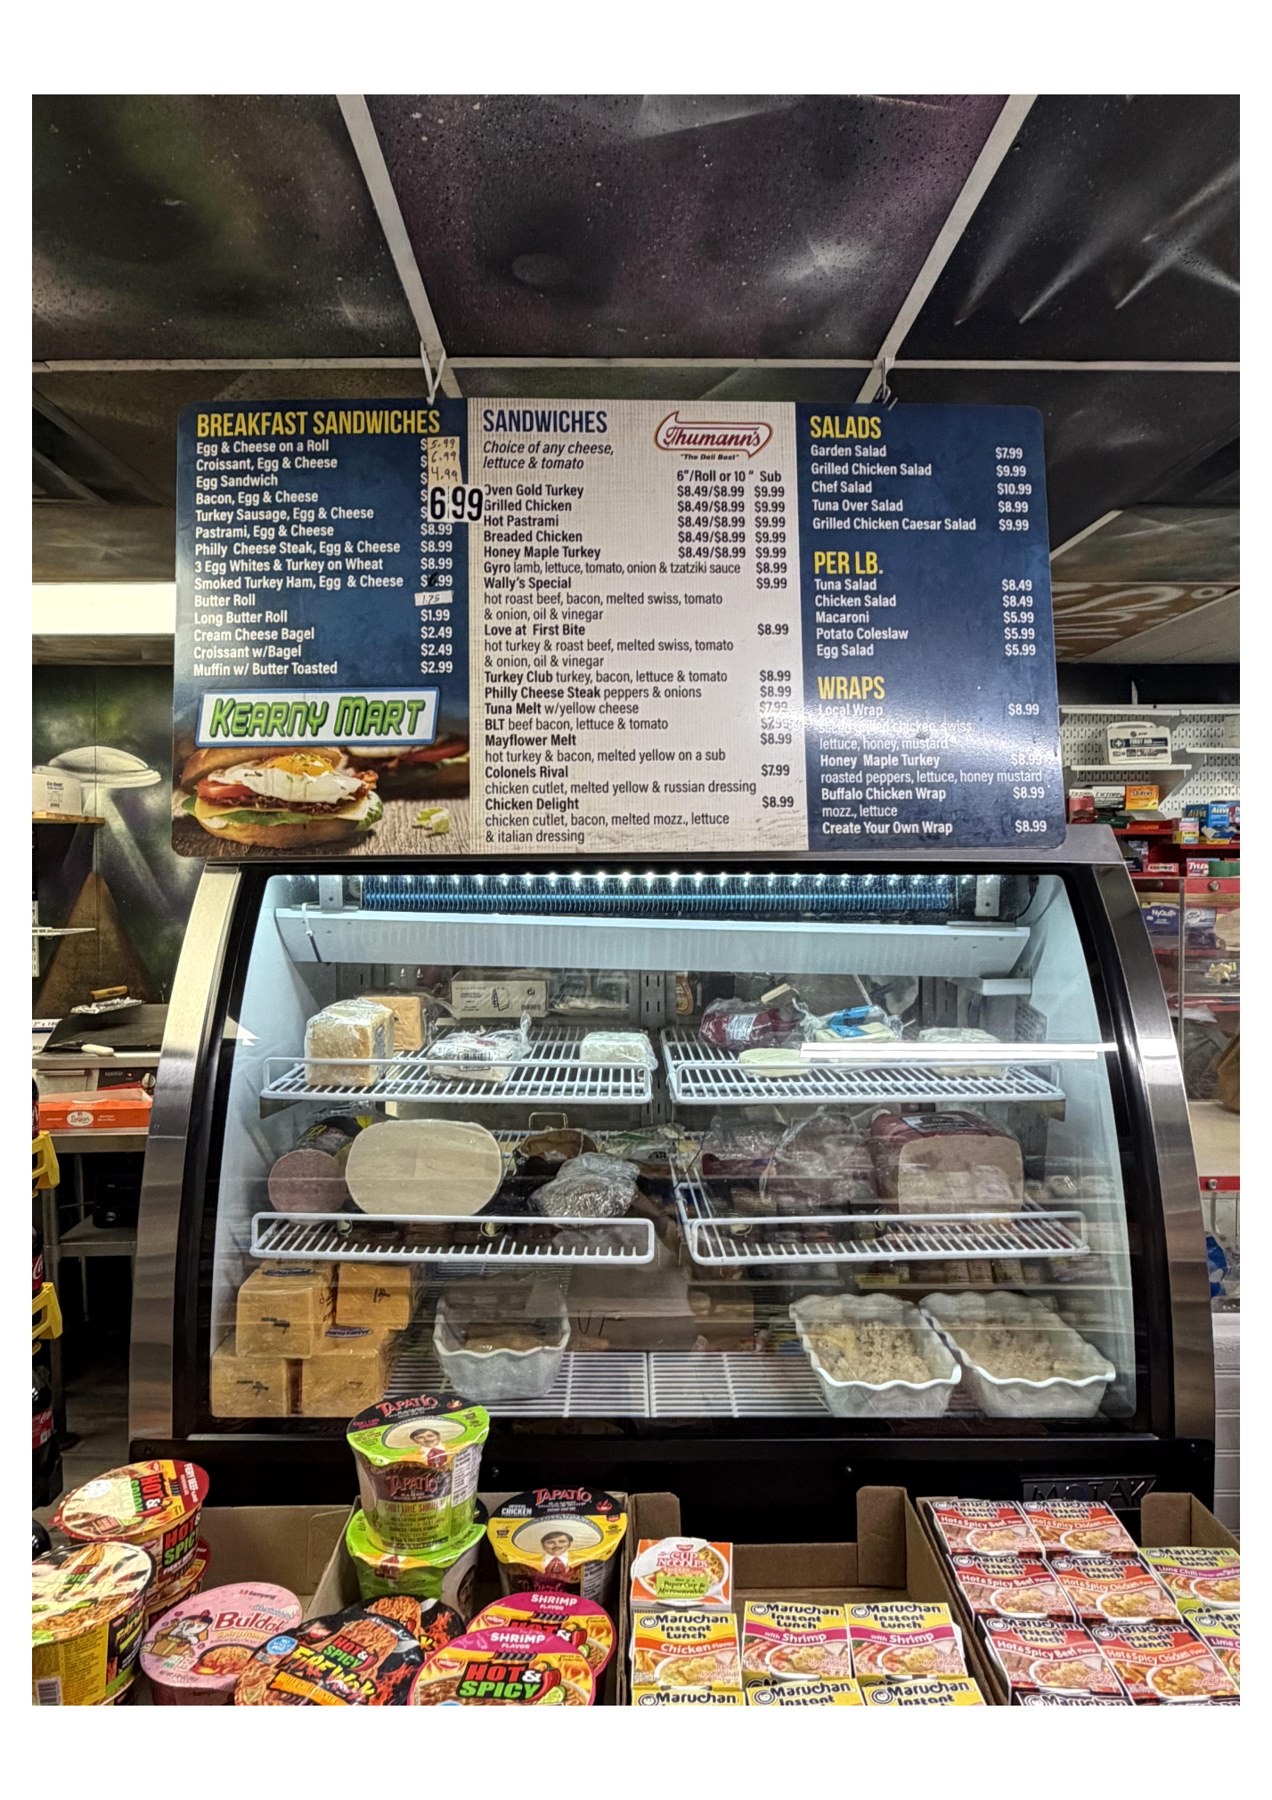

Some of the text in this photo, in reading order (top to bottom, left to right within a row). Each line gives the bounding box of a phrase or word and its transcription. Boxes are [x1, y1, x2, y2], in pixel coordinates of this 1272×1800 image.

[197, 410, 440, 437] BREAKFAST SANDWICHES
[483, 409, 608, 433] SANDWICHES
[810, 416, 882, 439] SALADS
[663, 426, 760, 447] Thumann's
[197, 439, 329, 456] Egg & Cheese on a Roll
[483, 441, 614, 456] Choice of any cheese,
[196, 457, 338, 471] Croissant, Egg & Cheese
[483, 456, 584, 470] lettuce & tomato
[811, 463, 1026, 477] Grilled Chicken Salad $9.99
[196, 474, 278, 490] Egg Sandwich
[719, 472, 731, 481] or
[760, 470, 781, 482] Sub
[484, 515, 786, 529] Hot Pastrami $8.49/$8.99 $9.99
[814, 551, 884, 574] PER LB.
[484, 577, 787, 590] Wally's Special $9.99
[814, 578, 1032, 591] Tuna Salad $8.49
[195, 595, 231, 607] Butter
[234, 594, 255, 607] Roll
[195, 609, 450, 626] Long Butter Roll $1.99
[194, 627, 452, 642] Cream Cheese Bagel $2.49
[484, 624, 789, 636] Love at First Bite $8.99
[816, 627, 1035, 640] Potato Coleslaw $5.99
[194, 644, 452, 660] Croissant w/Bagel $2.49
[194, 661, 453, 676] Muffin w/ Butter Toasted $2.99
[817, 676, 885, 700] WRAPS
[209, 696, 426, 738] KEARNY MART
[853, 704, 883, 718] Wrap
[1008, 703, 1039, 716] $8.99
[485, 733, 791, 748] Mayflower Melt $8.99
[485, 765, 790, 778] Colonels Rival $7.99
[821, 787, 1044, 801] Buffalo Chicken Wrap $8.99
[485, 796, 794, 812] Chicken Delight $8.99
[822, 820, 1047, 835] Create Your Own Wrap $8.99
[485, 830, 585, 844] & italian dressing
[501, 1507, 532, 1516] CHICKEN
[531, 1594, 578, 1607] SHRIMP
[763, 1604, 840, 1616] Maruchan
[213, 1611, 285, 1633] Buldak
[655, 1613, 729, 1625] Maruchan
[771, 1613, 822, 1623] Instant
[776, 1620, 818, 1630] Lunch
[660, 1624, 712, 1633] Instant
[666, 1630, 707, 1640] Lunch
[1013, 1627, 1065, 1637] Instant
[491, 1632, 546, 1644] SHRIMP
[782, 1630, 827, 1644] Shrimp
[1022, 1634, 1064, 1644] Lunch
[332, 1636, 363, 1655] HOT
[660, 1641, 711, 1654] Chicken
[323, 1644, 362, 1669] SPICY
[465, 1663, 525, 1681] HOT
[522, 1670, 542, 1682] &
[459, 1681, 541, 1698] SPICY
